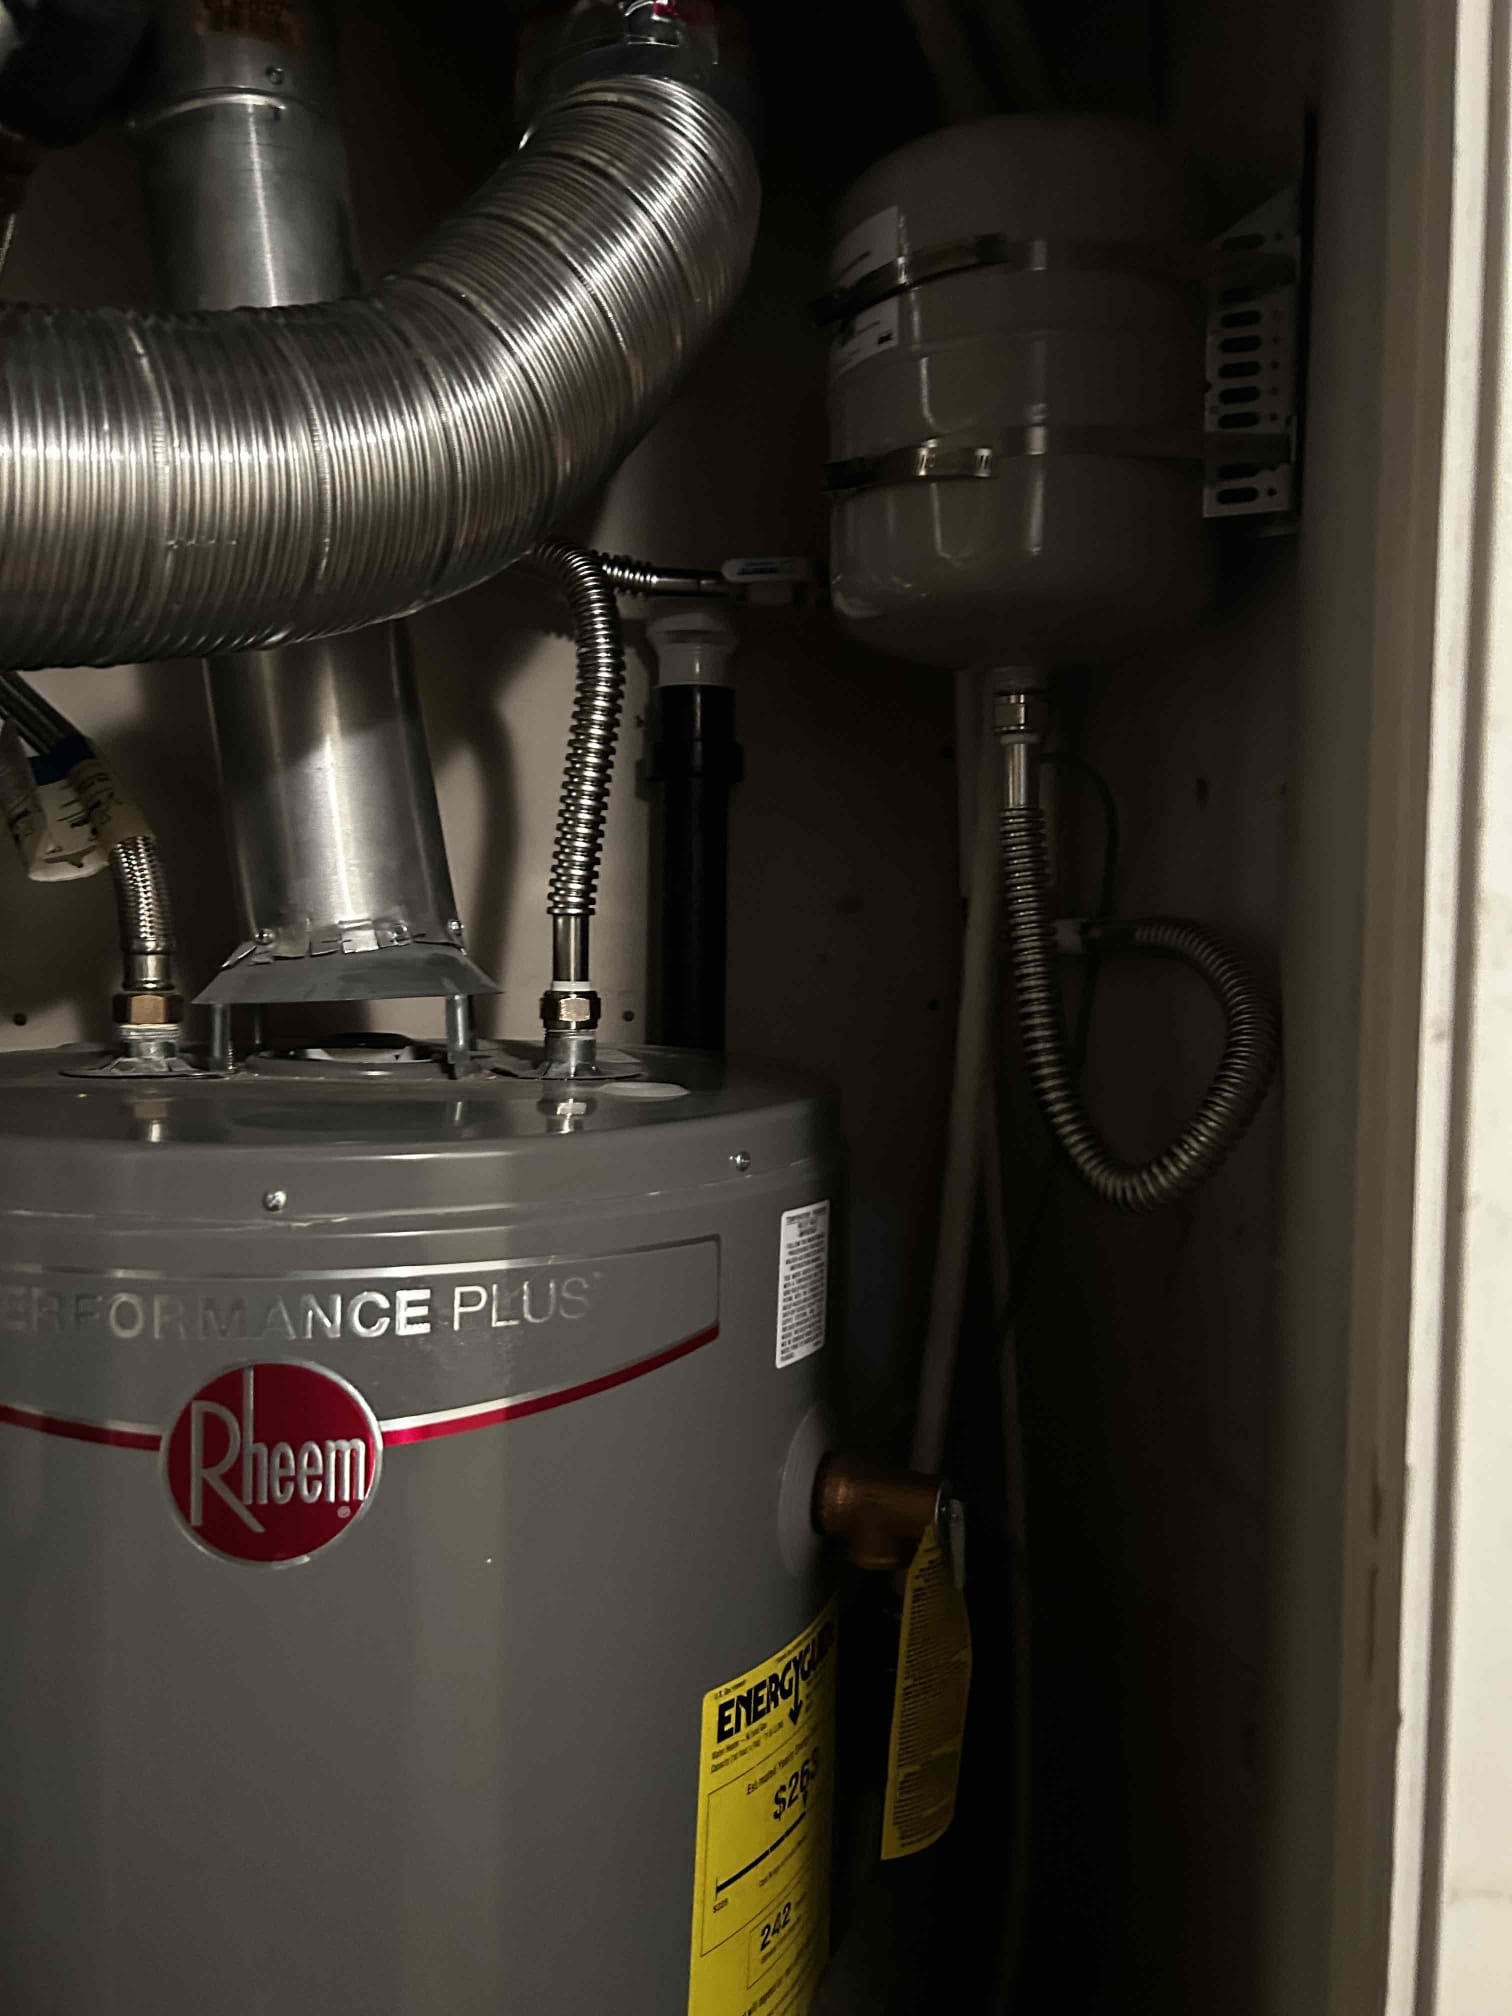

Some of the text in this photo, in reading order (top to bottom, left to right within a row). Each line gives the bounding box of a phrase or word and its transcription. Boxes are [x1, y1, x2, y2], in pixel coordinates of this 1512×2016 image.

[0, 1276, 590, 1340] ERFORMANCE PLUS
[190, 1366, 367, 1534] Rheem
[760, 1901, 791, 1952] 242
